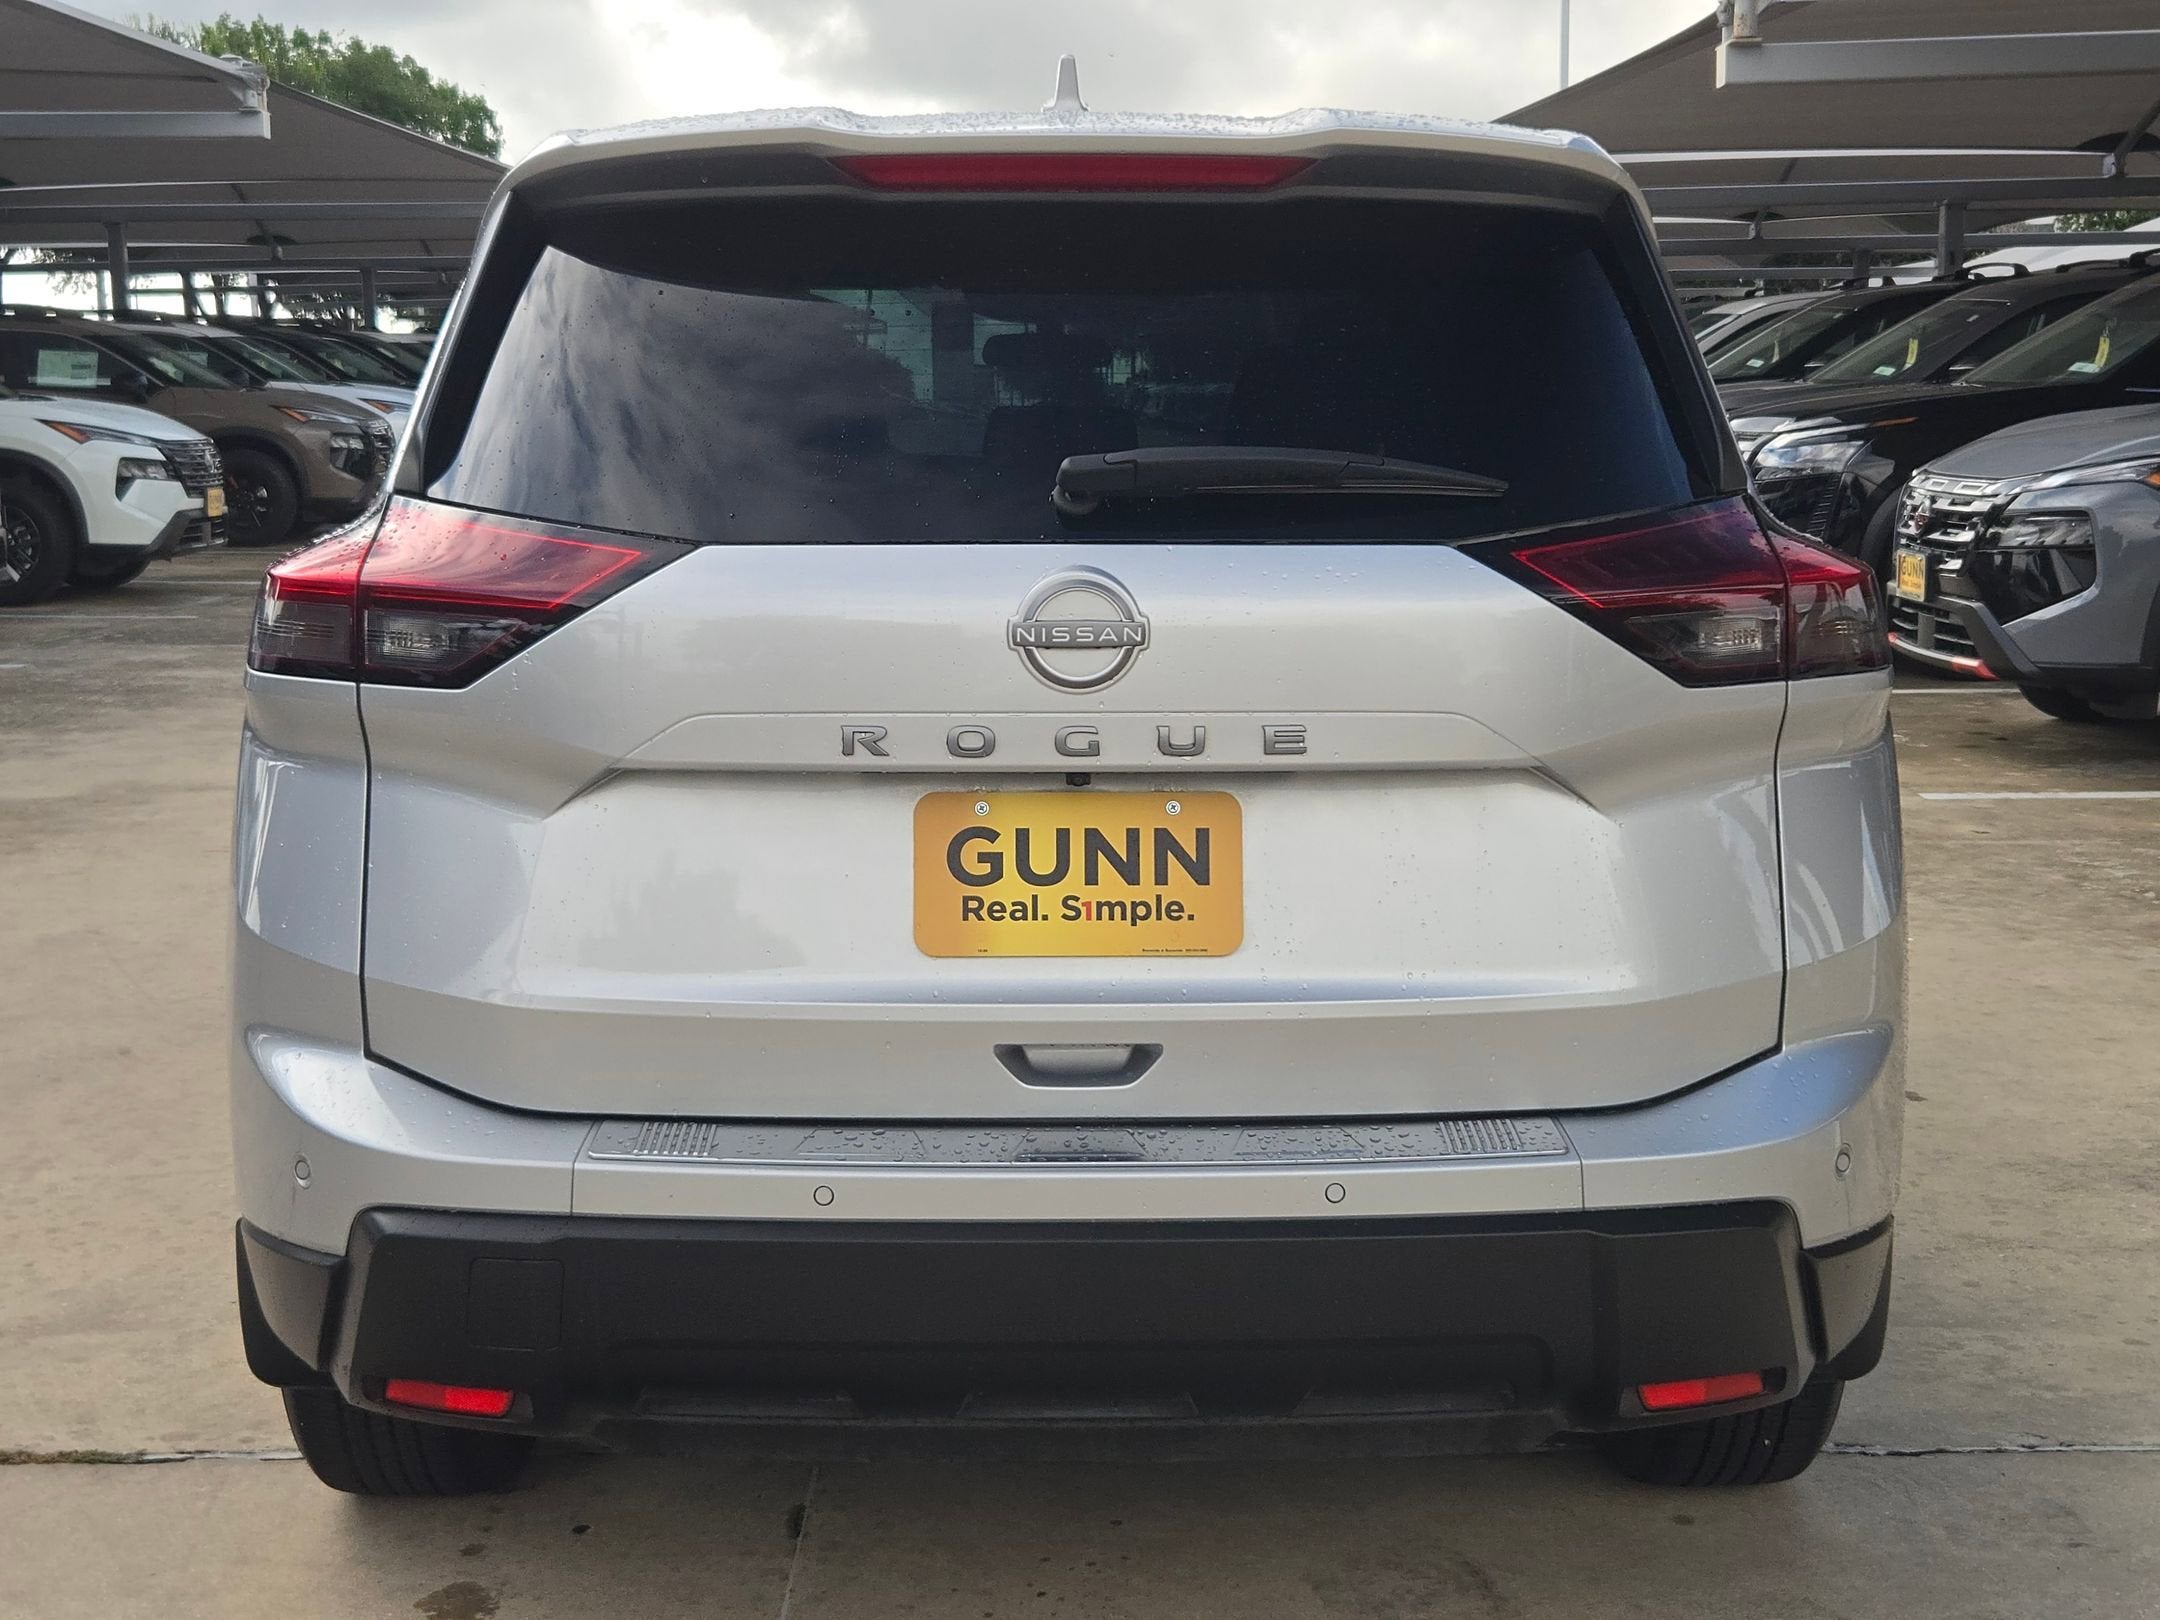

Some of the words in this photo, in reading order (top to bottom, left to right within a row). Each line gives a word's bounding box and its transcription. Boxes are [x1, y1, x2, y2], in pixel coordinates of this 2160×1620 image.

[1016, 627, 1142, 642] NISSAN
[840, 725, 1307, 757] ROGUE
[946, 826, 1211, 887] GUNN
[961, 894, 1049, 921] Real.
[1060, 894, 1195, 926] S1mple.
